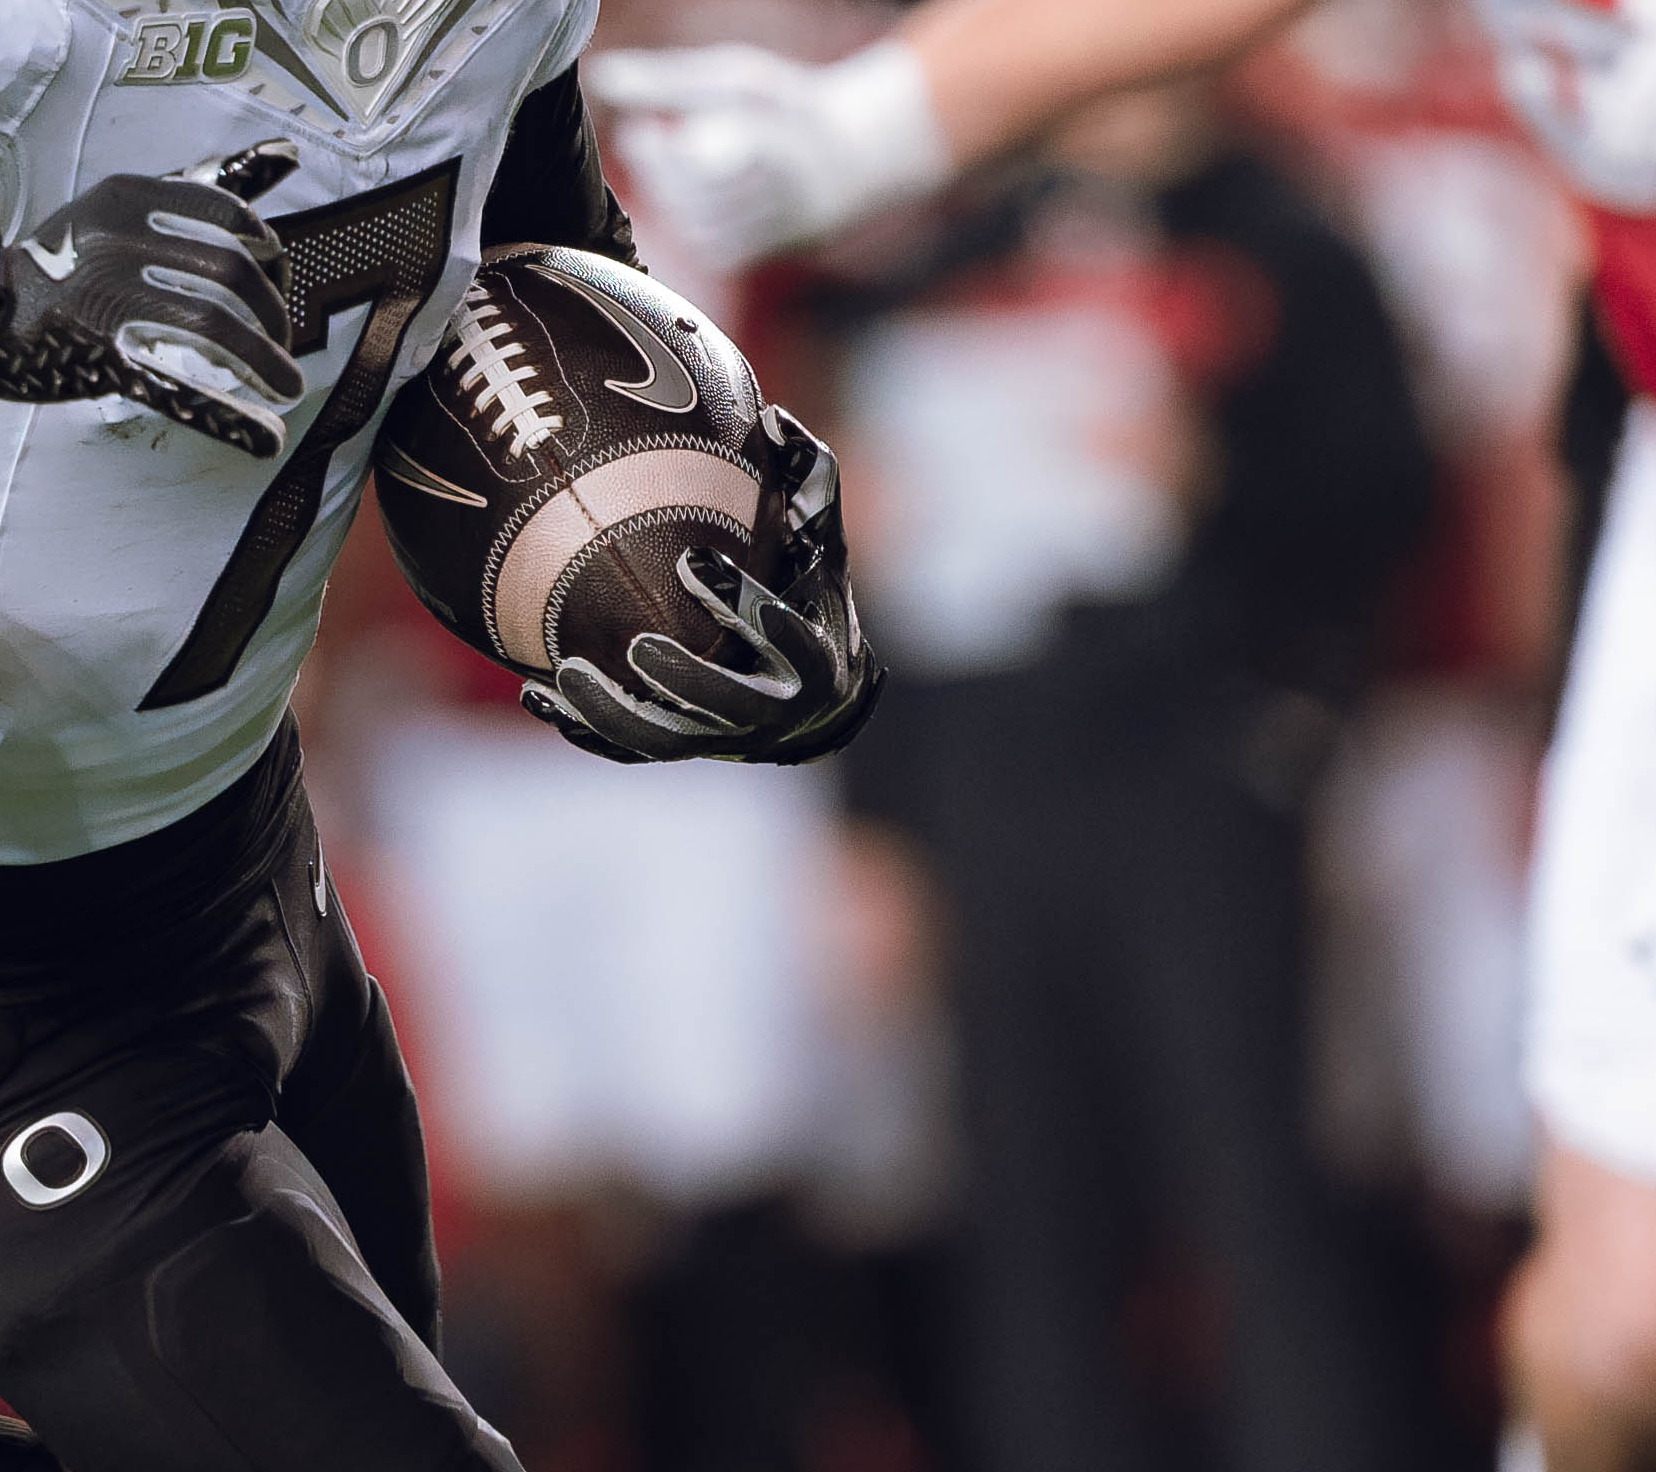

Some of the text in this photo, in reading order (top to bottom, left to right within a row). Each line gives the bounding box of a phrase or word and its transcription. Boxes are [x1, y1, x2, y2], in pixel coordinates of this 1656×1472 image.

[343, 16, 400, 88] O
[135, 154, 463, 713] 7
[0, 1109, 109, 1209] O
